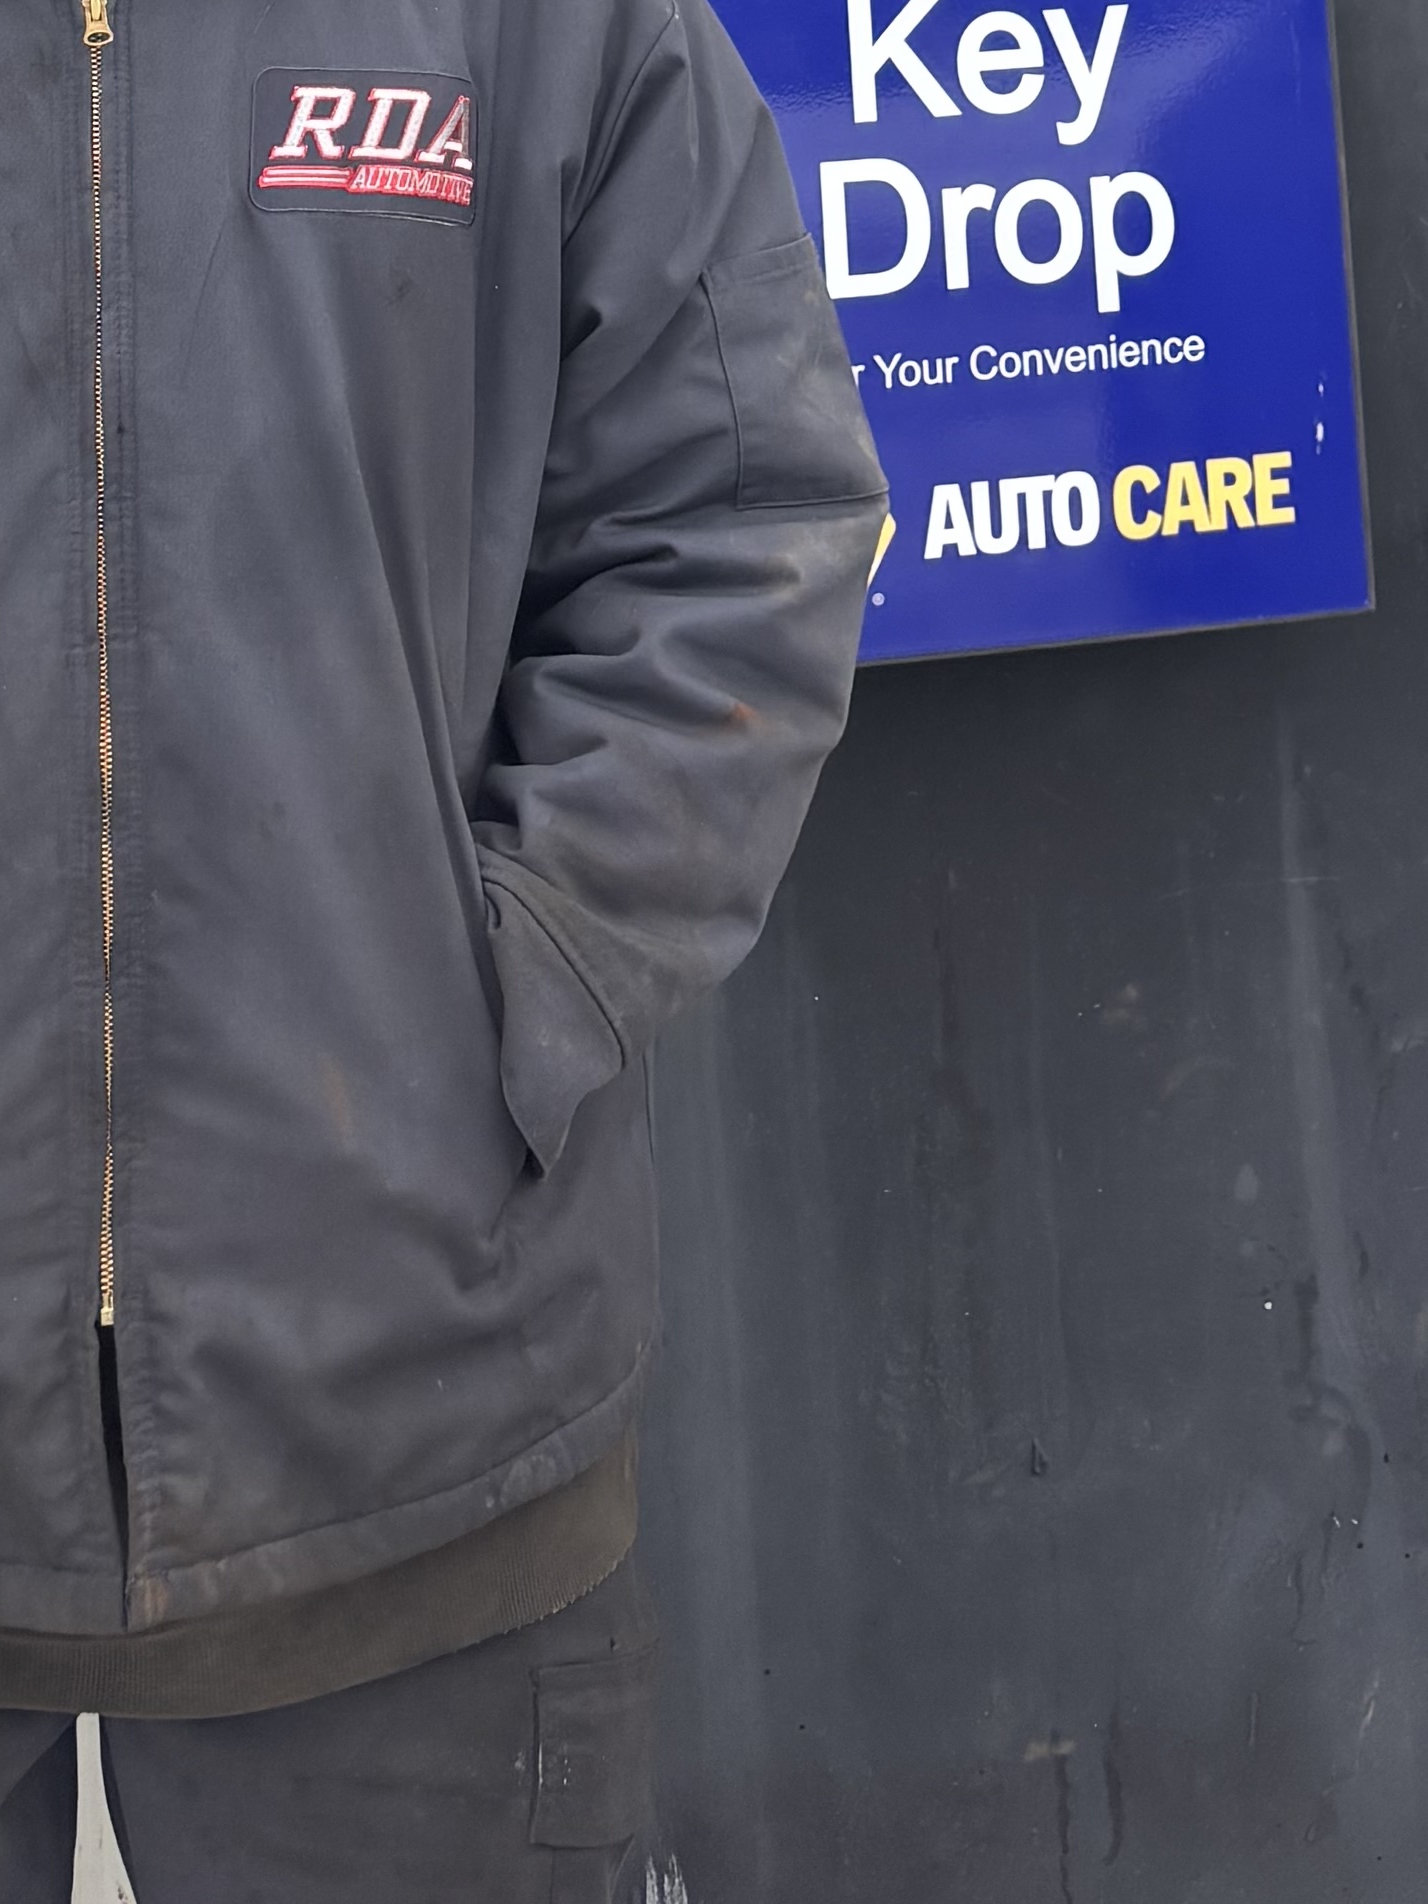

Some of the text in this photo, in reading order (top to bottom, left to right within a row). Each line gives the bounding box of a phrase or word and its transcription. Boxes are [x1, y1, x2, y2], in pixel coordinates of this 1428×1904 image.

[269, 85, 473, 171] RDA
[818, 156, 1176, 314] Drop
[873, 352, 960, 389] Your
[969, 334, 1205, 381] Convenience
[923, 451, 1296, 560] AUTO CARE
